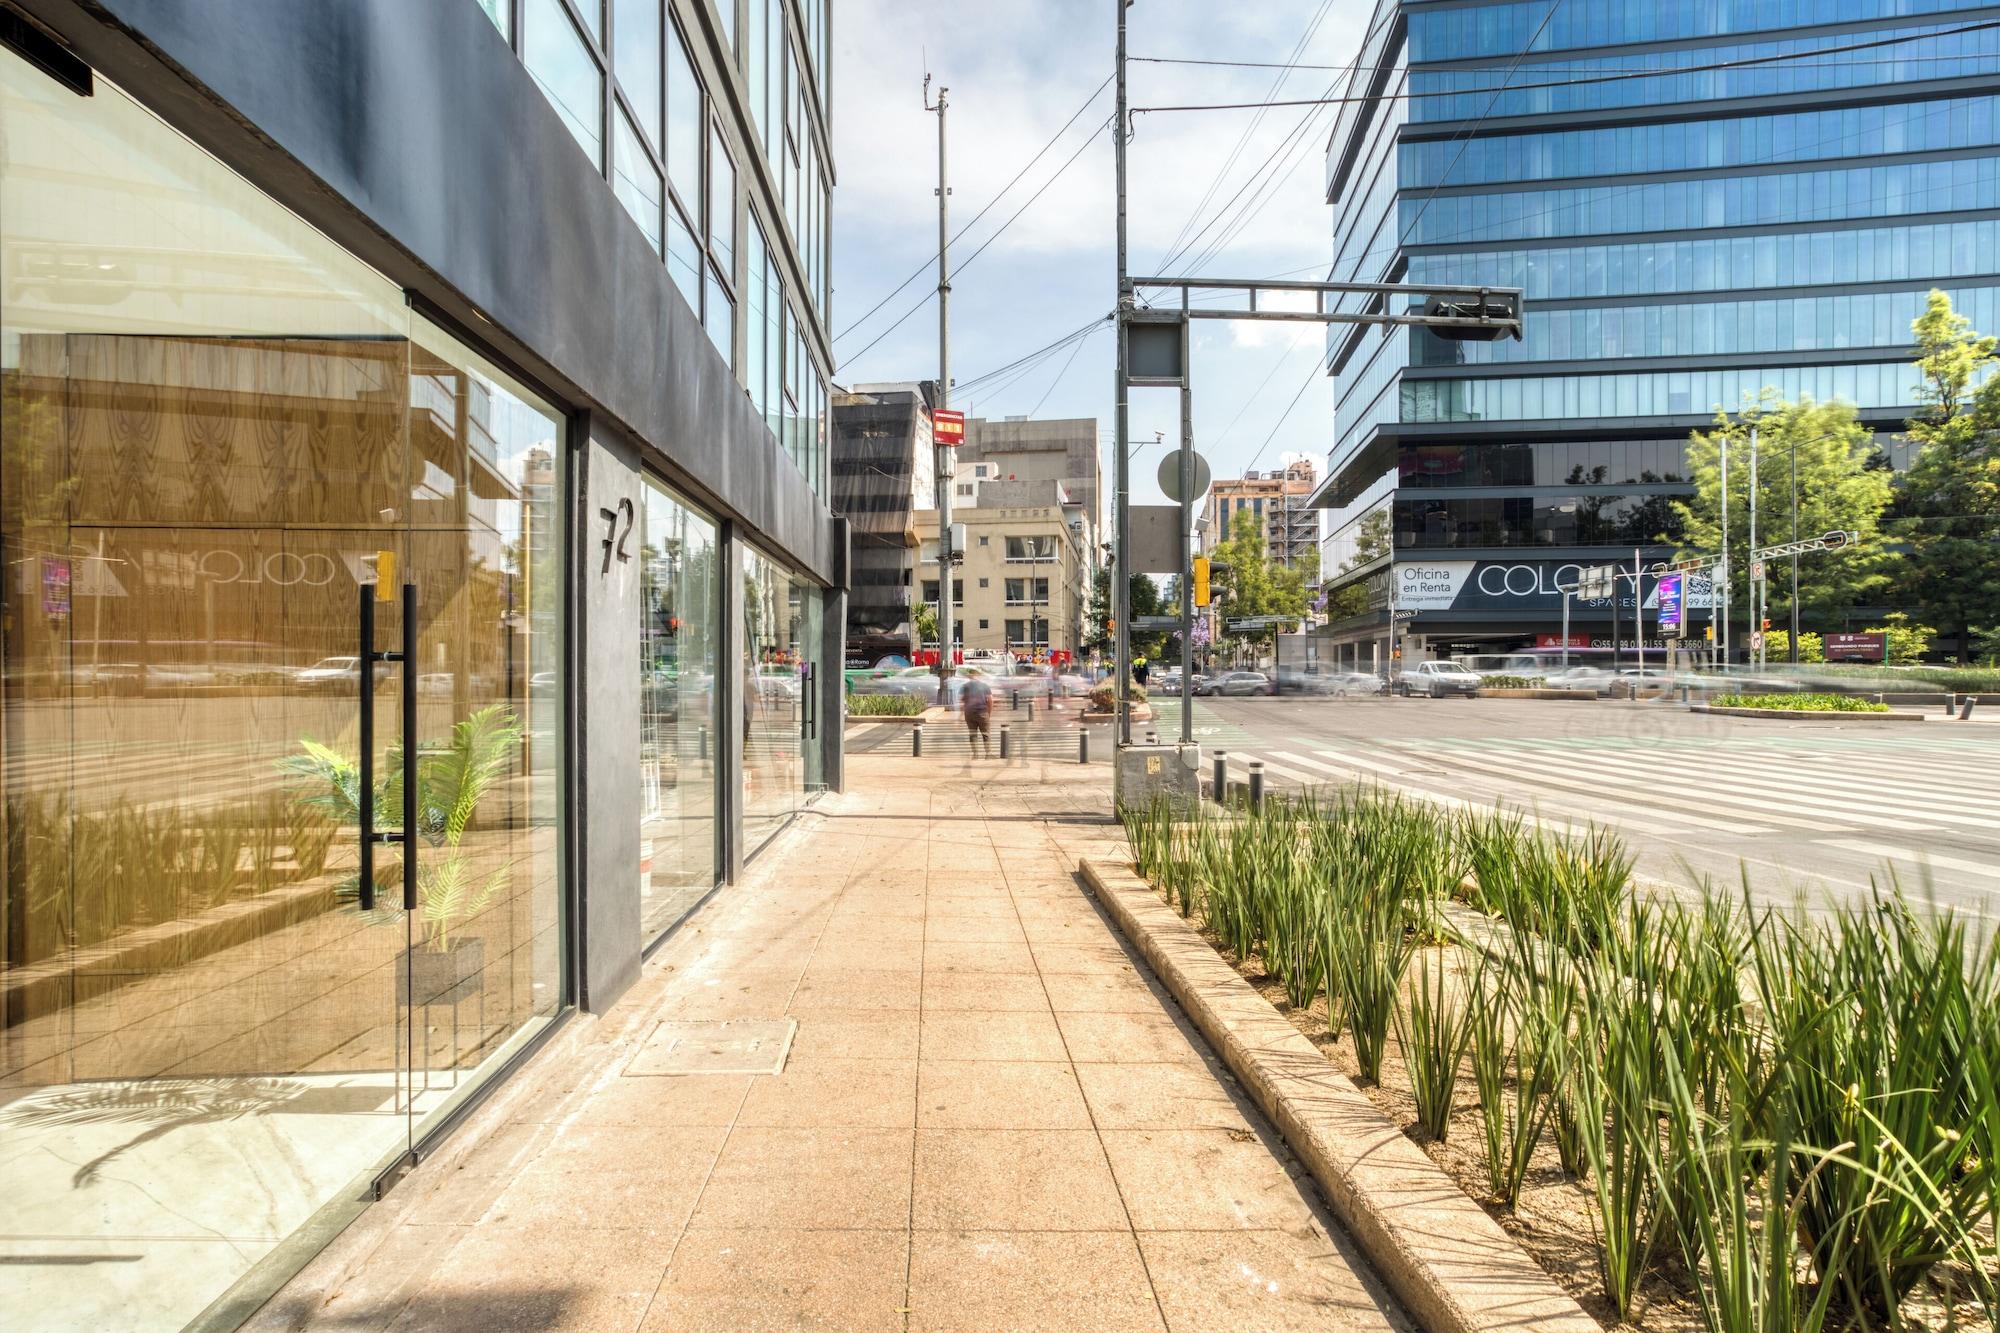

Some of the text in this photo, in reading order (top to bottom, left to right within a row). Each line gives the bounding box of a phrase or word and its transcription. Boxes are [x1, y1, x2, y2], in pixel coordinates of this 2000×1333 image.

[600, 497, 634, 575] 72
[1404, 567, 1450, 580] Oficina
[1478, 564, 1649, 596] COLOY
[1403, 582, 1451, 593] en Renta
[1589, 598, 1637, 607] SPAES
[1602, 640, 1611, 648] 55
